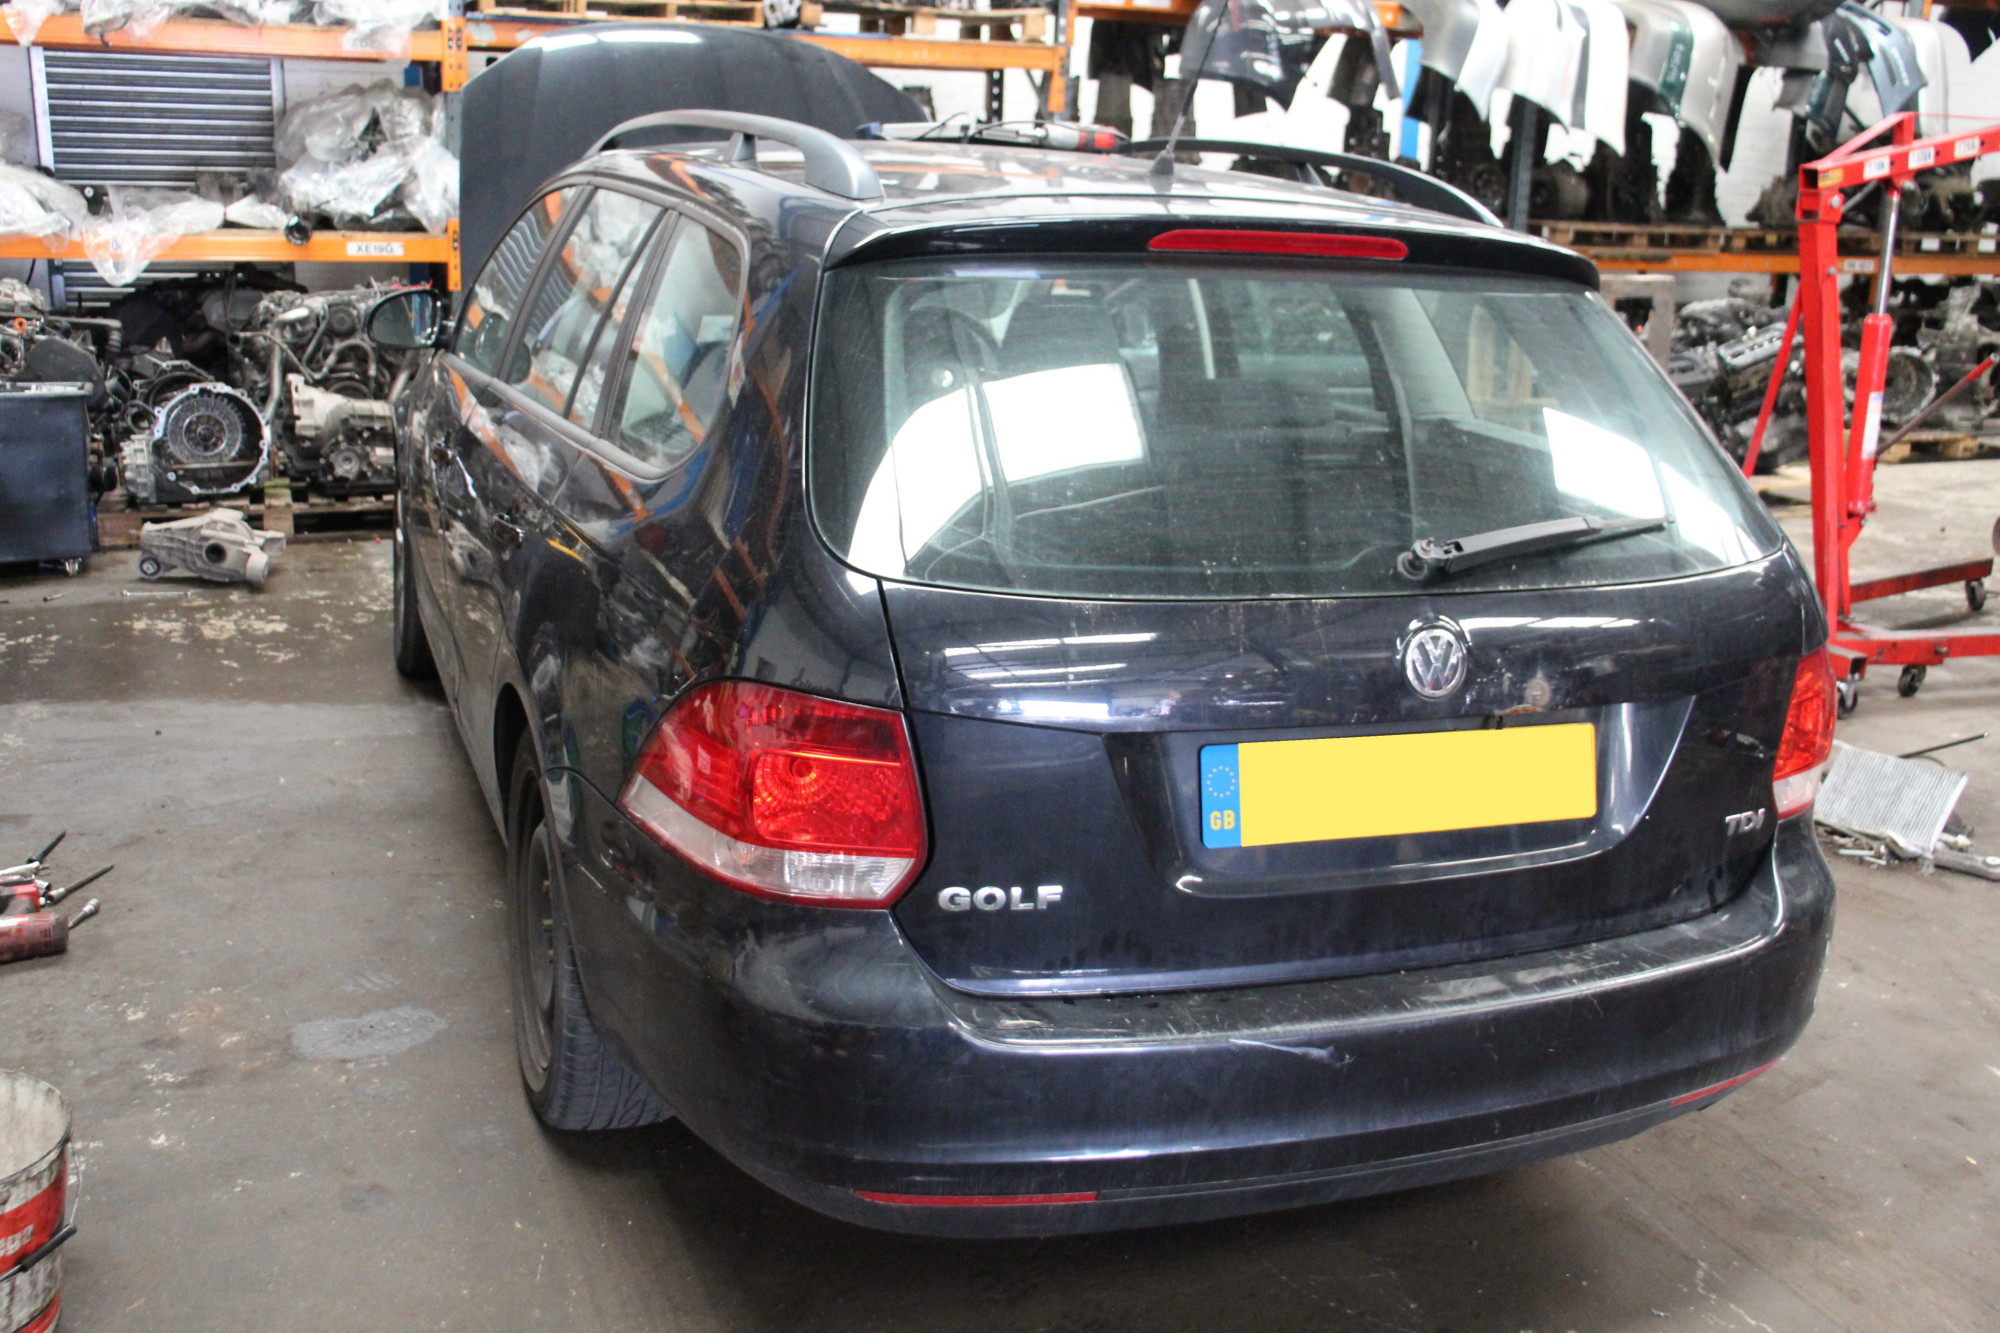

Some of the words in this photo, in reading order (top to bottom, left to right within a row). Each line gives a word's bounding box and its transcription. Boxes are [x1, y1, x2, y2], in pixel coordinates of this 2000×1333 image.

[1210, 810, 1236, 831] GB
[1725, 808, 1766, 836] TDI
[938, 885, 1063, 912] GOLF
